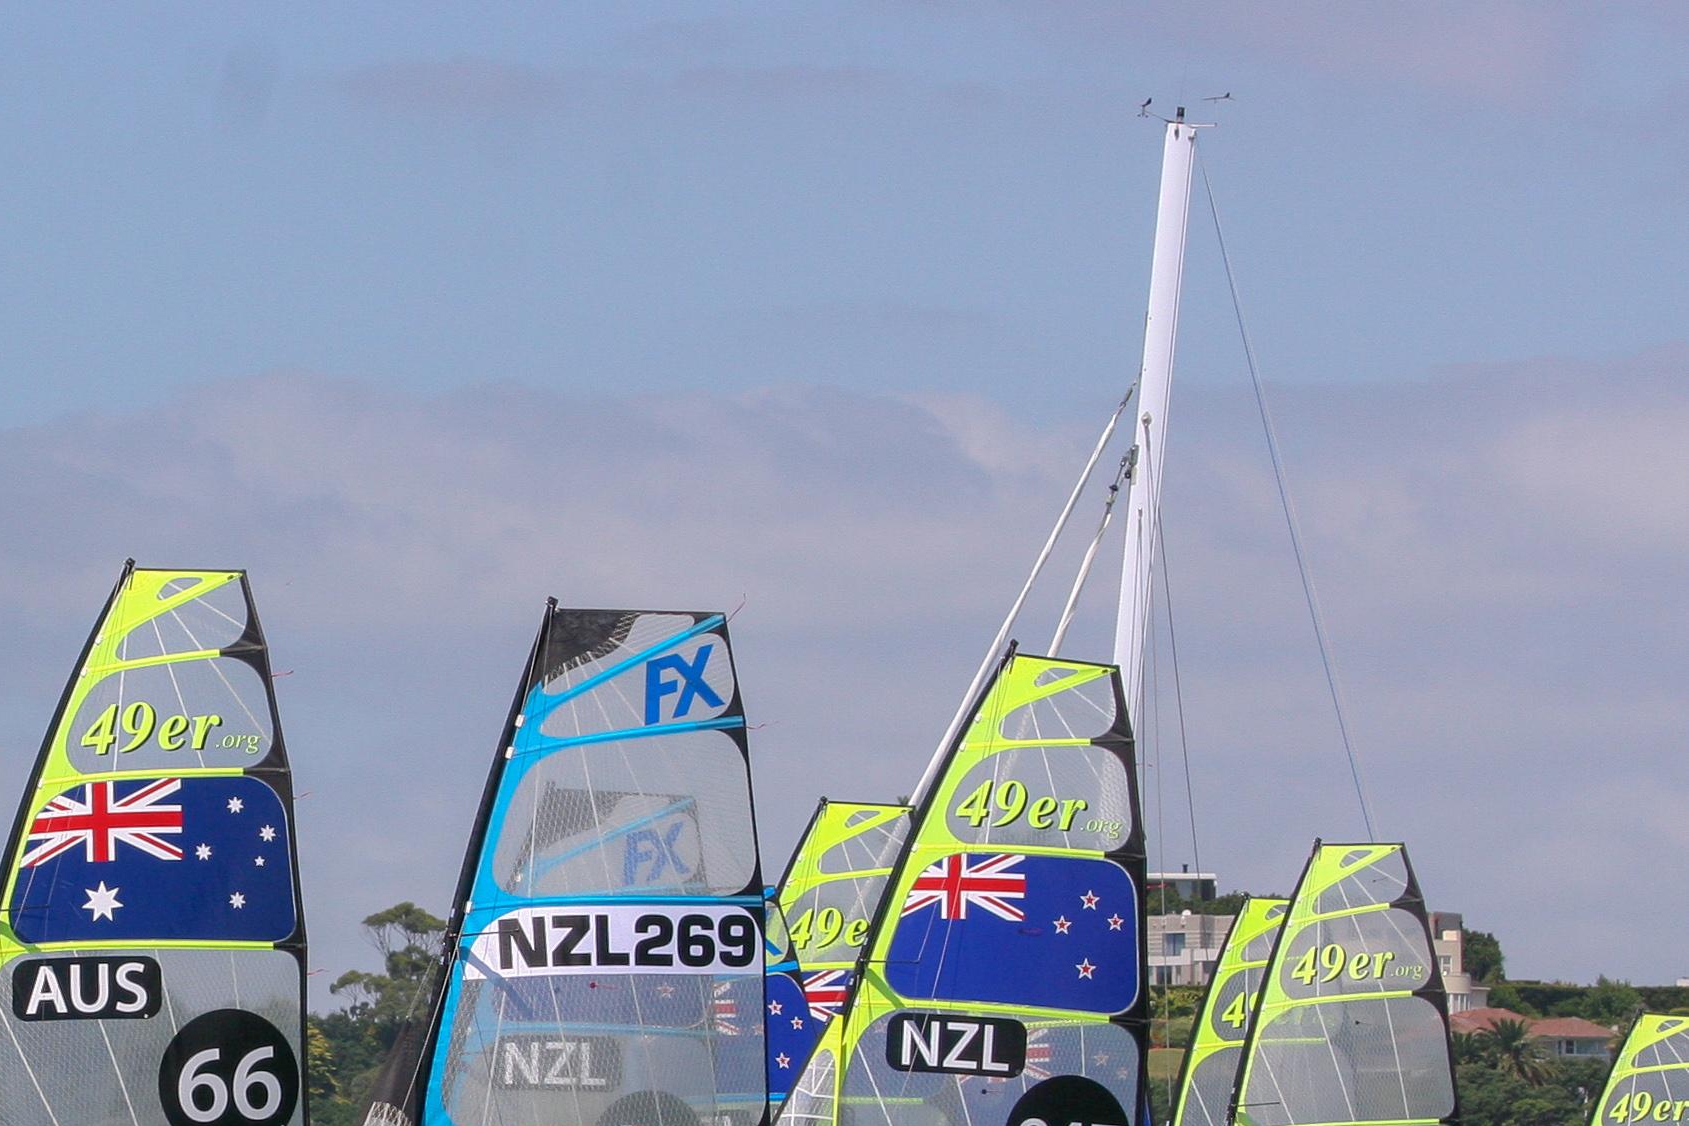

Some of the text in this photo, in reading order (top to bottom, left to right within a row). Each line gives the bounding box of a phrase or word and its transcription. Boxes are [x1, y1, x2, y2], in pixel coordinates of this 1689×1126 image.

[644, 643, 725, 726] FX
[497, 914, 756, 970] NZL269
[25, 962, 149, 1016] AUS
[504, 1041, 606, 1087] NZL
[901, 1020, 1010, 1072] NZL
[177, 1046, 283, 1123] 66
